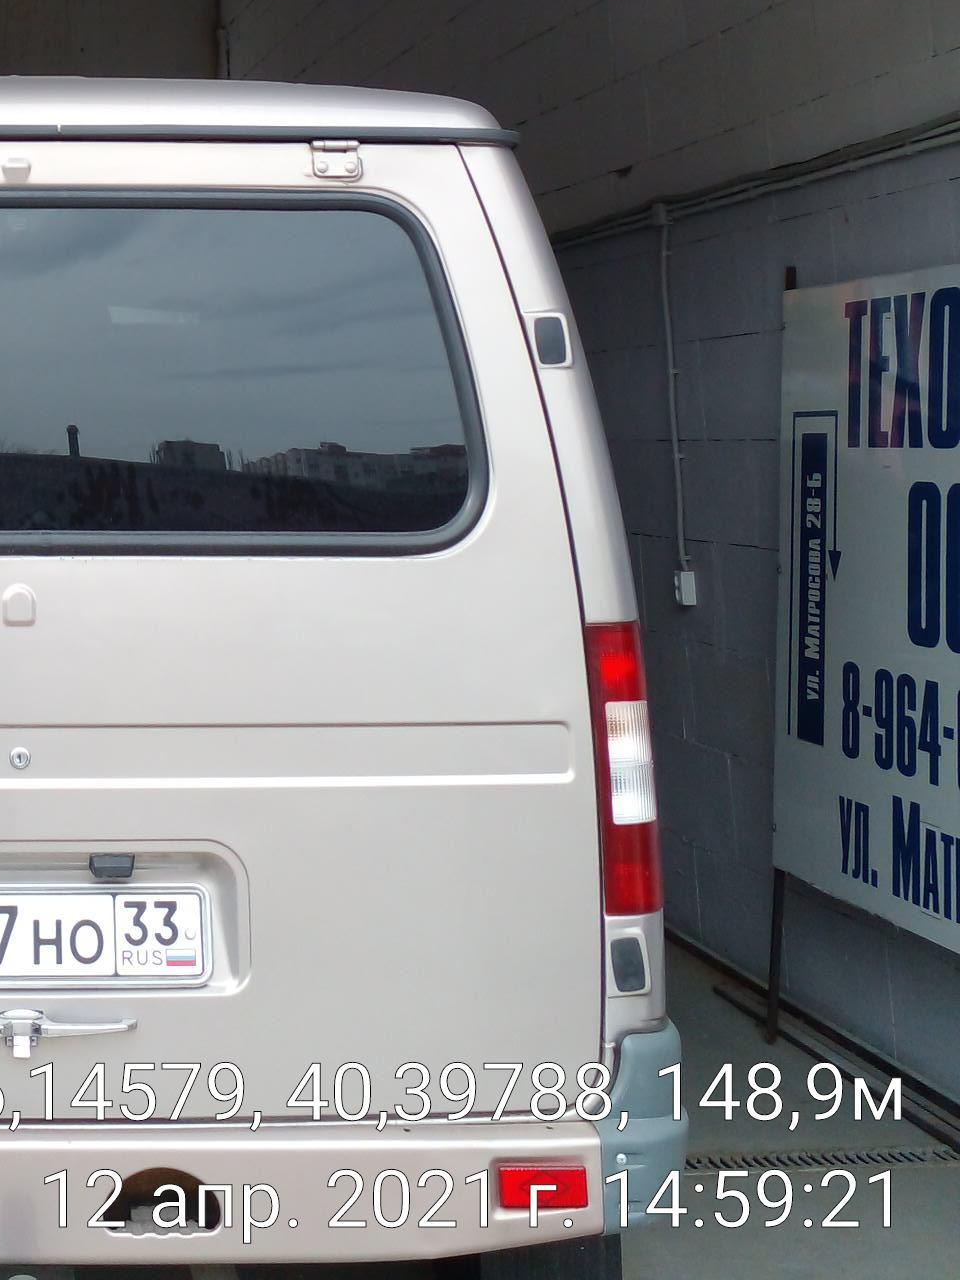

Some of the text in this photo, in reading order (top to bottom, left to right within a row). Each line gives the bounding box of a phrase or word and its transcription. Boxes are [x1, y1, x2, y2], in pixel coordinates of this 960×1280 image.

[842, 661, 960, 790] 8-964-
[122, 900, 179, 947] 33
[121, 949, 163, 967] RUS
